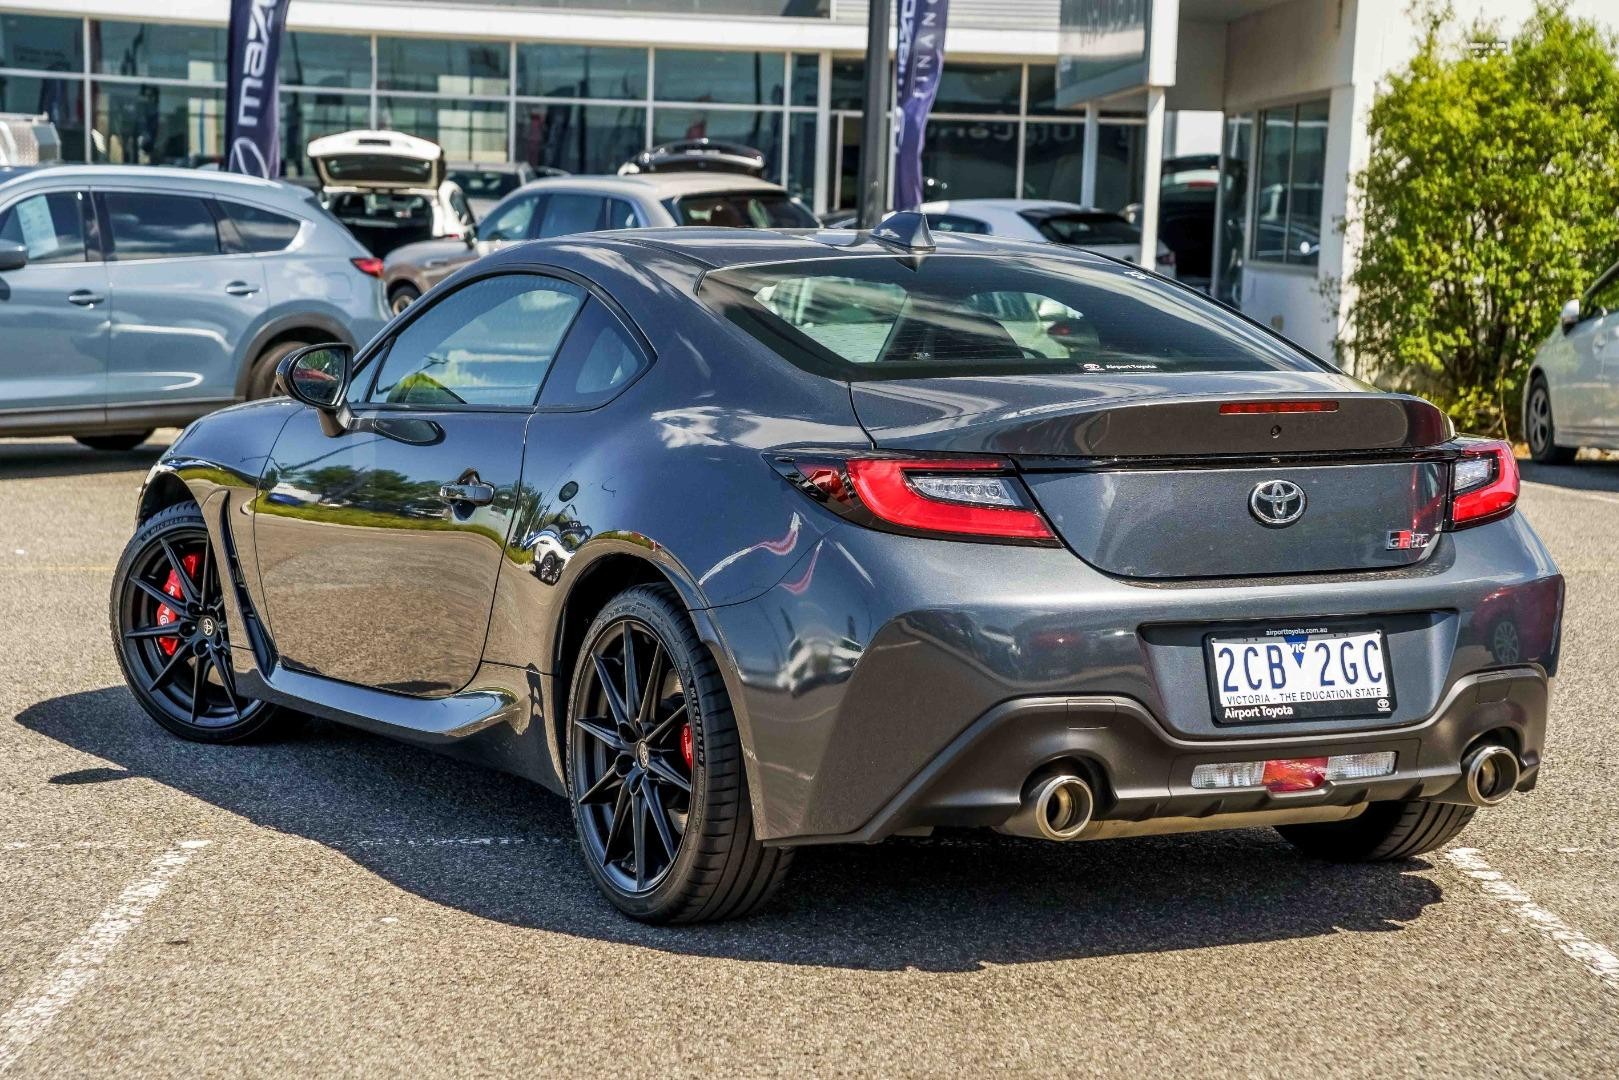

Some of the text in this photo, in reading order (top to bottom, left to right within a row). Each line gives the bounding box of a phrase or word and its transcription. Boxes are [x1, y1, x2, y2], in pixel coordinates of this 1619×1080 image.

[238, 0, 276, 126] maz
[912, 0, 938, 99] FINAN
[1265, 627, 1328, 636] airporttoyota.com.au
[1218, 639, 1383, 692] 2CB 2GC
[1224, 704, 1294, 721] Airport Toyota
[1226, 696, 1270, 705] VICTORIA
[1280, 692, 1297, 702] THE
[1300, 689, 1352, 701] EDUCATION
[1356, 687, 1382, 697] STATE
[689, 687, 704, 763] MICHELIN
